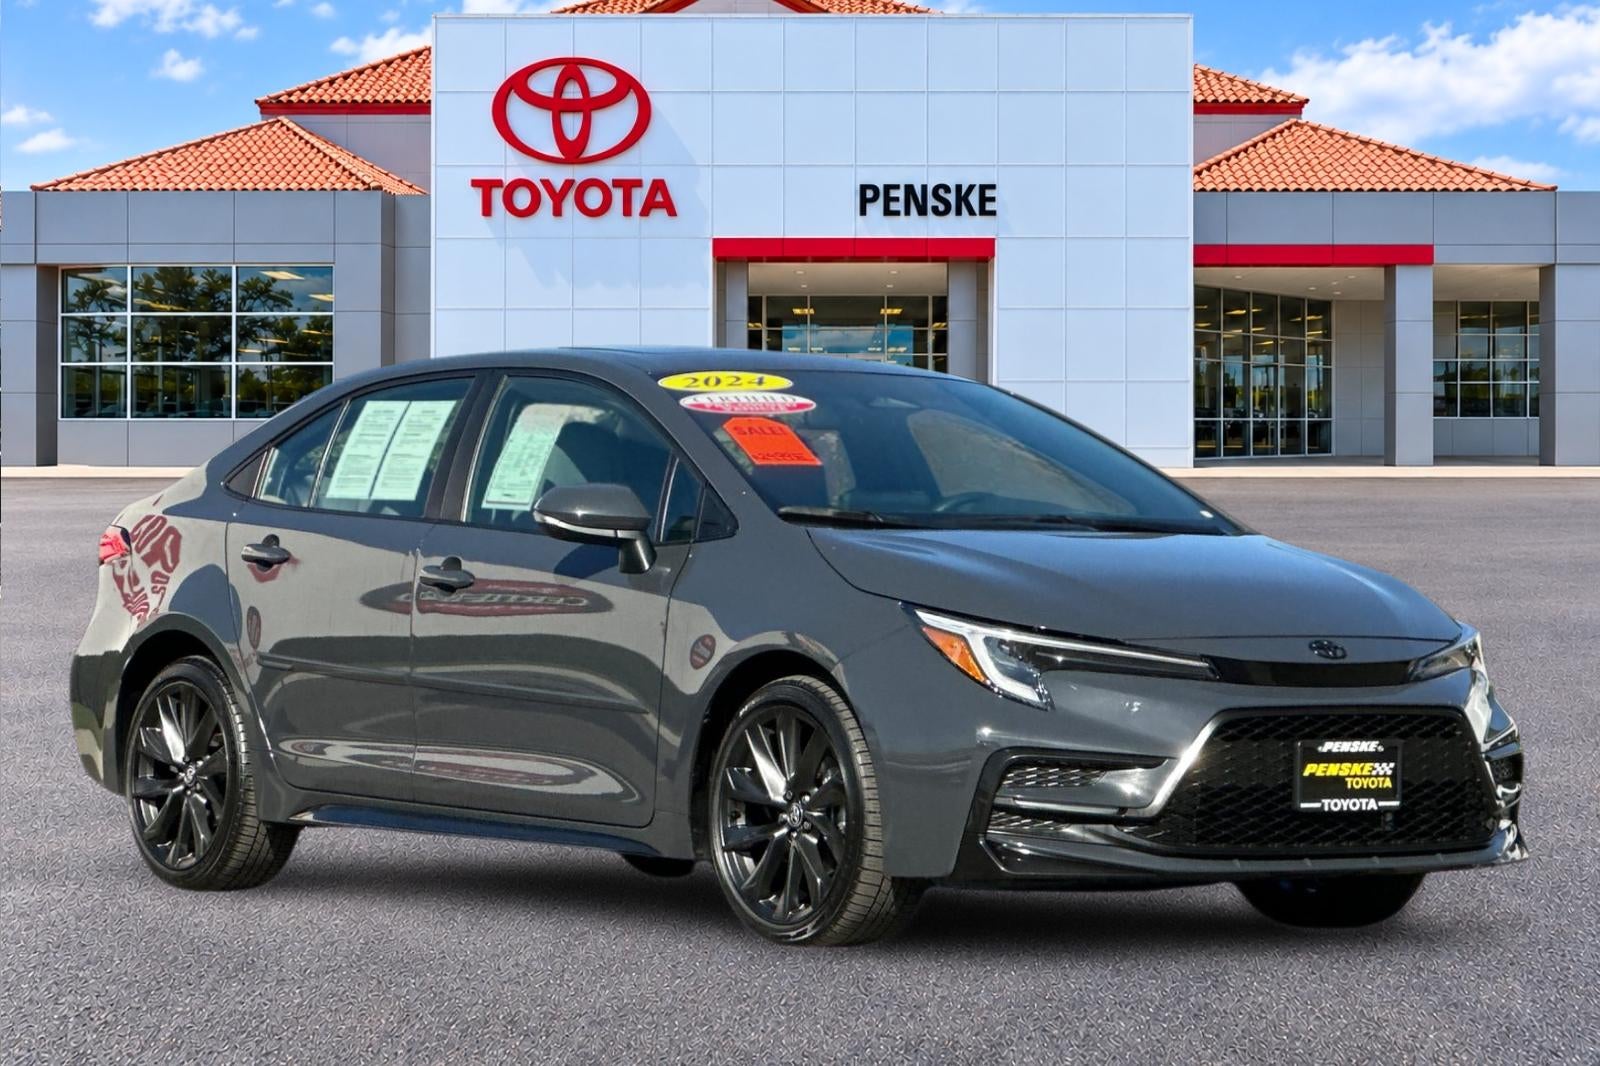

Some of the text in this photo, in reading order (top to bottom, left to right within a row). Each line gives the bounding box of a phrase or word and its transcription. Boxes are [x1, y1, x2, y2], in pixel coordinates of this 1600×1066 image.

[471, 178, 677, 217] TOYOTA
[859, 183, 996, 216] PENSKE
[683, 375, 766, 388] 2024
[1321, 741, 1379, 752] PENSKE
[1303, 763, 1373, 776] PENSKE
[1345, 777, 1392, 789] TOYOTA
[1321, 798, 1378, 811] TOYOTA
